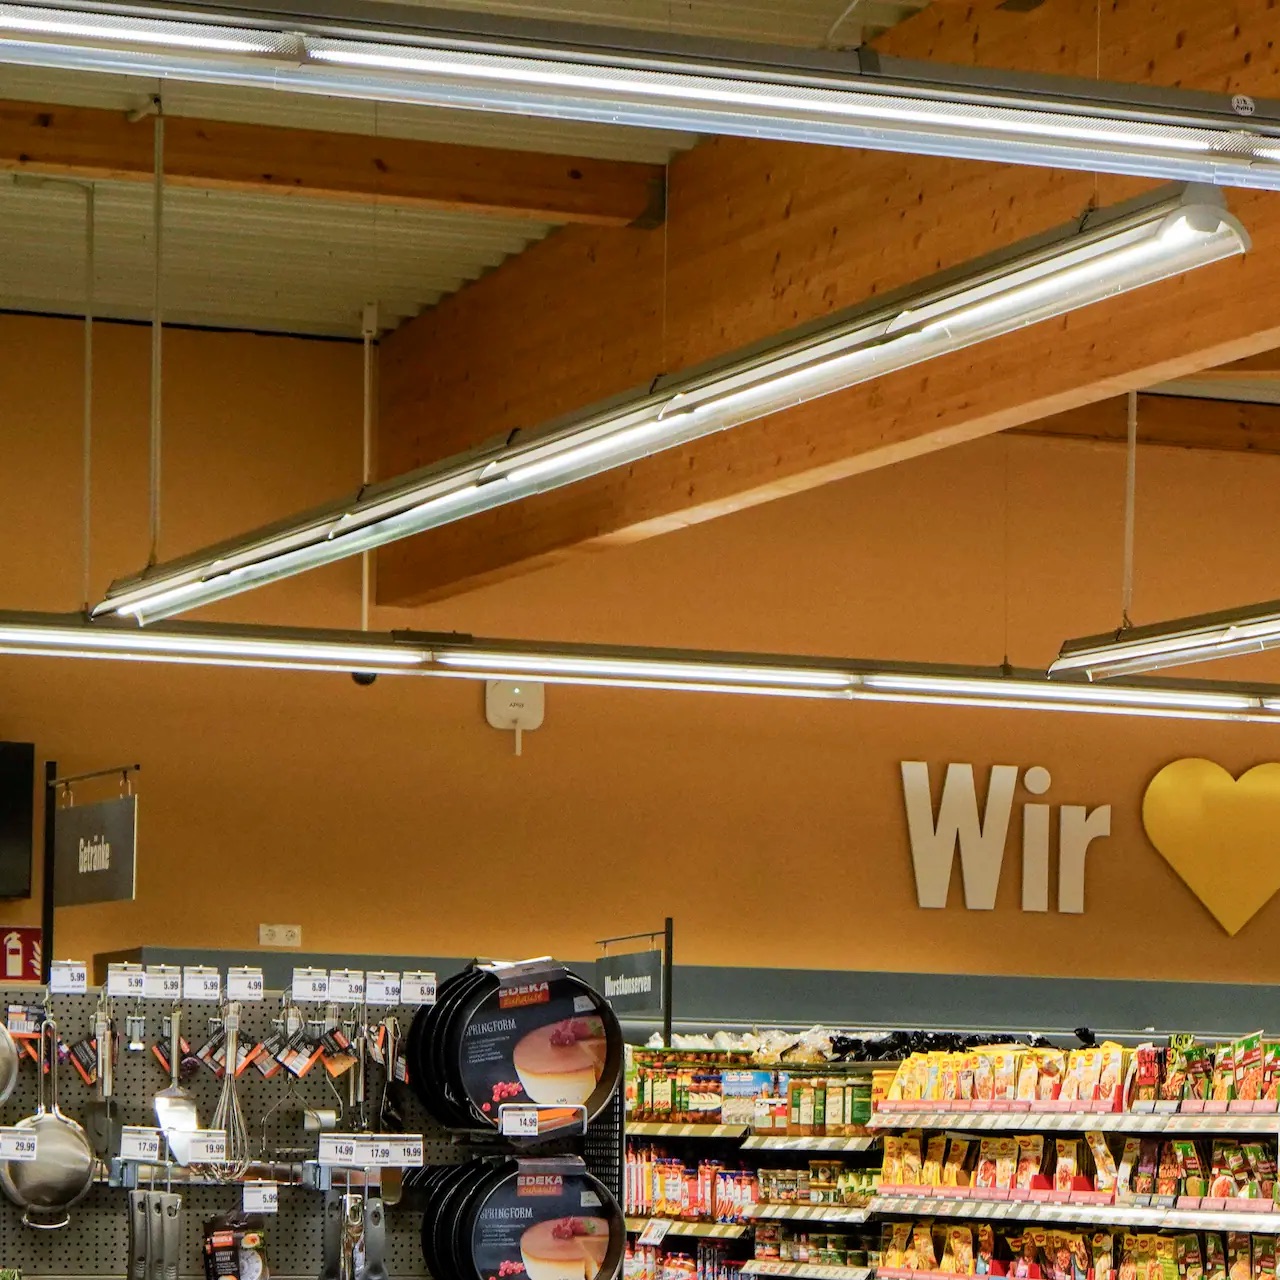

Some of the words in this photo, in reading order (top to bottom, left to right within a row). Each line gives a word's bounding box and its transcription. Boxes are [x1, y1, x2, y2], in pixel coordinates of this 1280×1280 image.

[900, 759, 1111, 914] Wir
[79, 834, 110, 873] Getränke
[604, 974, 652, 997] Wurstkonserven
[15, 1140, 36, 1152] 29.99
[138, 1141, 158, 1152] 17.99
[205, 1143, 225, 1154] 19.99
[402, 1147, 422, 1158] 19.99
[517, 1175, 563, 1186] EDEKA
